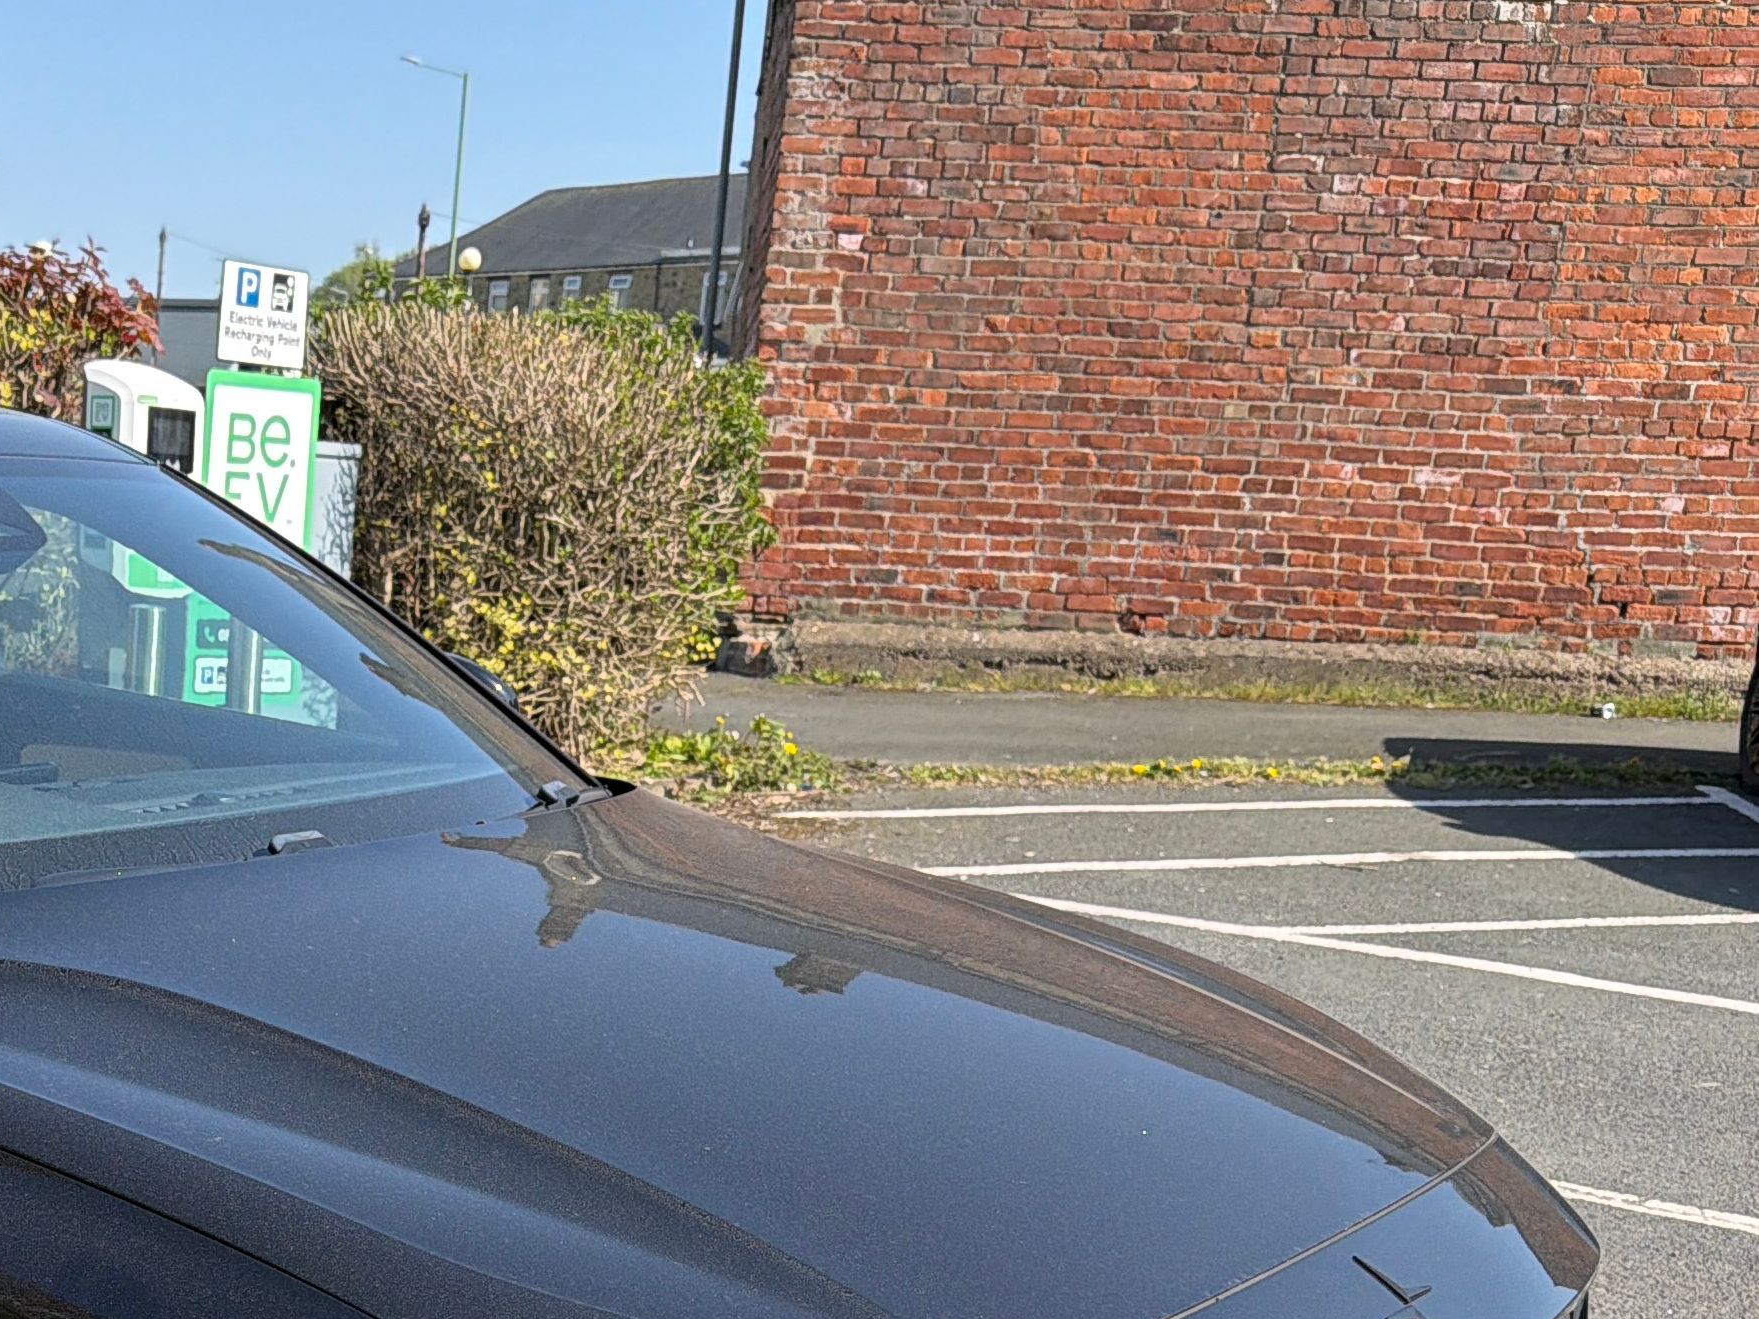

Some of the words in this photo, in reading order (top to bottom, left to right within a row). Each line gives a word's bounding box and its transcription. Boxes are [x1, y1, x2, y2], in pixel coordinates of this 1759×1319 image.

[229, 310, 264, 327] Electric
[266, 315, 298, 332] Vehicle
[224, 326, 275, 346] Recharging
[277, 333, 300, 347] Point
[250, 345, 272, 360] Only
